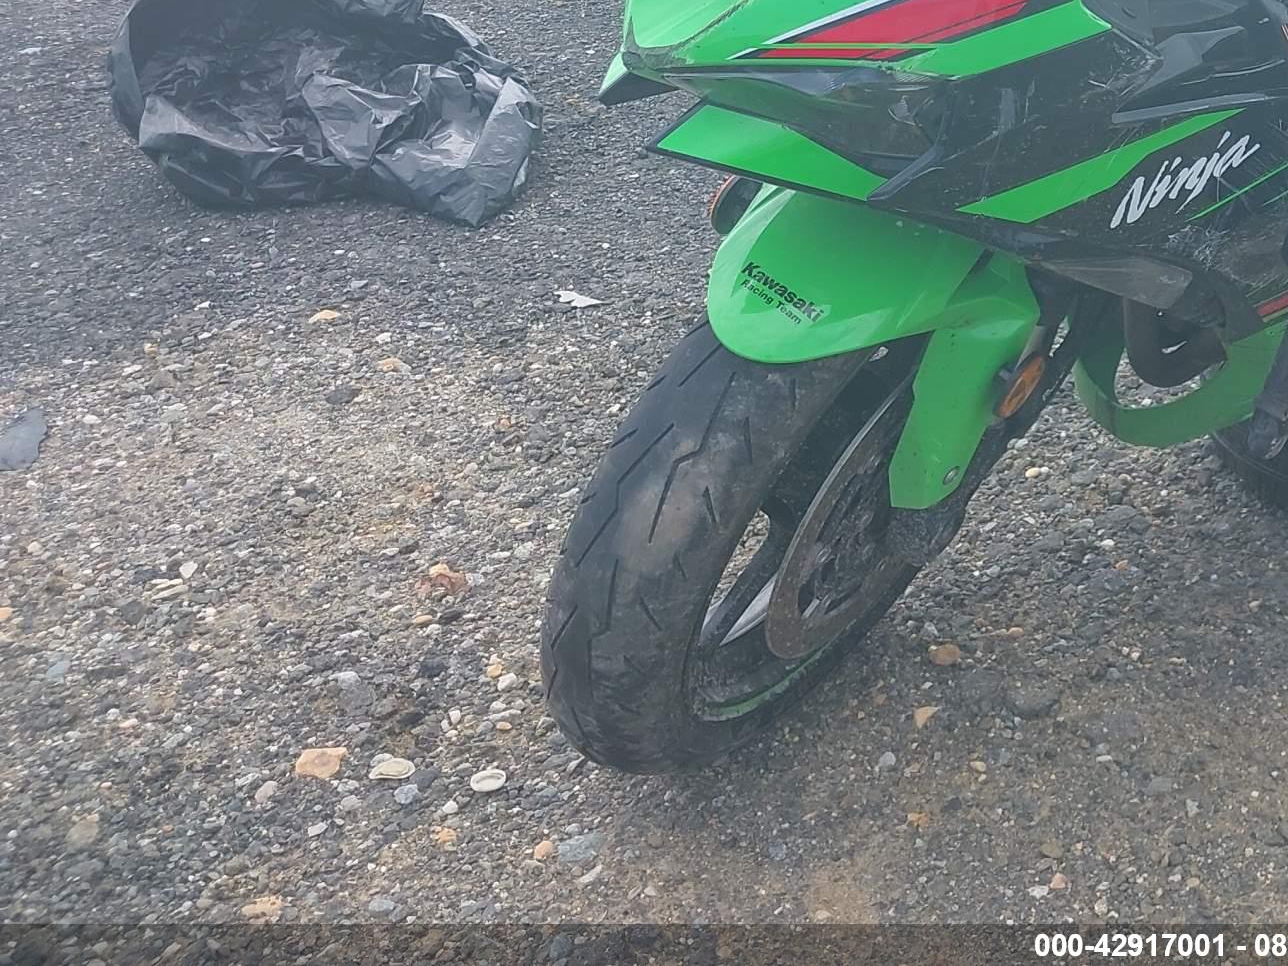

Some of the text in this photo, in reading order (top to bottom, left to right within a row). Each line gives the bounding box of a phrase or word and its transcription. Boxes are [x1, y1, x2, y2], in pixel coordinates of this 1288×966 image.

[1110, 131, 1260, 229] Ninja
[741, 261, 824, 323] Kawasaki
[741, 279, 802, 324] Racing Team
